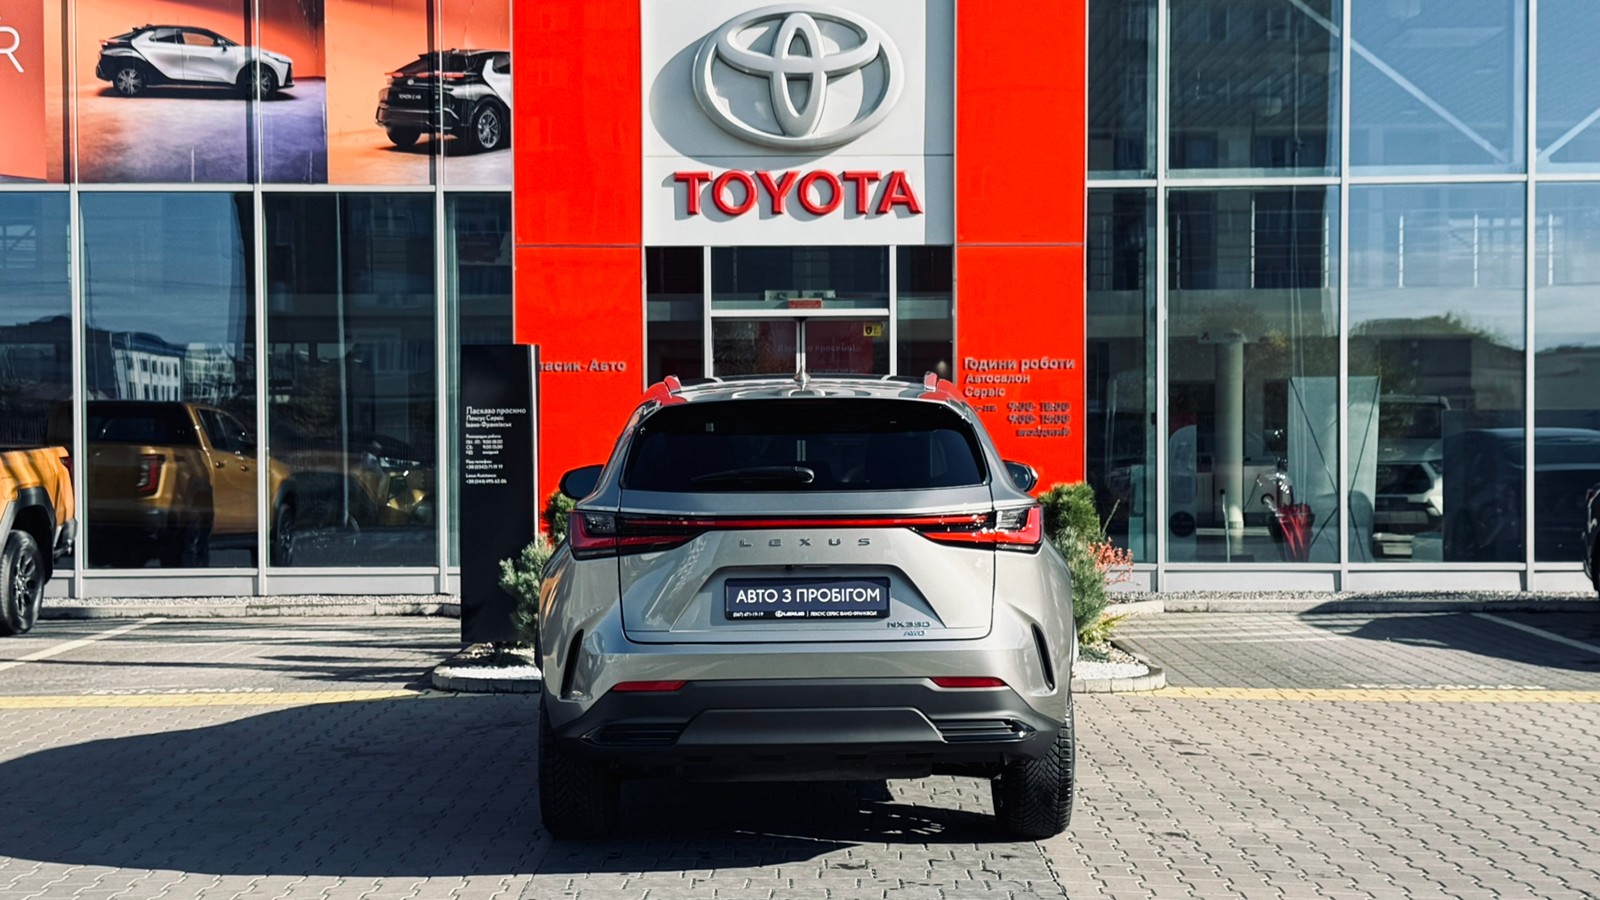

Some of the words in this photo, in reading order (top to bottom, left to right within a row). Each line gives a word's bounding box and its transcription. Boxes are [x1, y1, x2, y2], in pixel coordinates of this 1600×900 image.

[674, 169, 923, 215] TOYOTA
[963, 357, 1016, 371] Години
[1020, 356, 1076, 372] роботи
[965, 374, 1031, 384] Автосалон
[964, 386, 1006, 399] Сервіс
[496, 407, 527, 416] просимо
[739, 538, 871, 547] LEXUS
[736, 589, 778, 603] АВТО
[782, 589, 792, 602] З
[796, 588, 880, 603] ПРОБІГОМ
